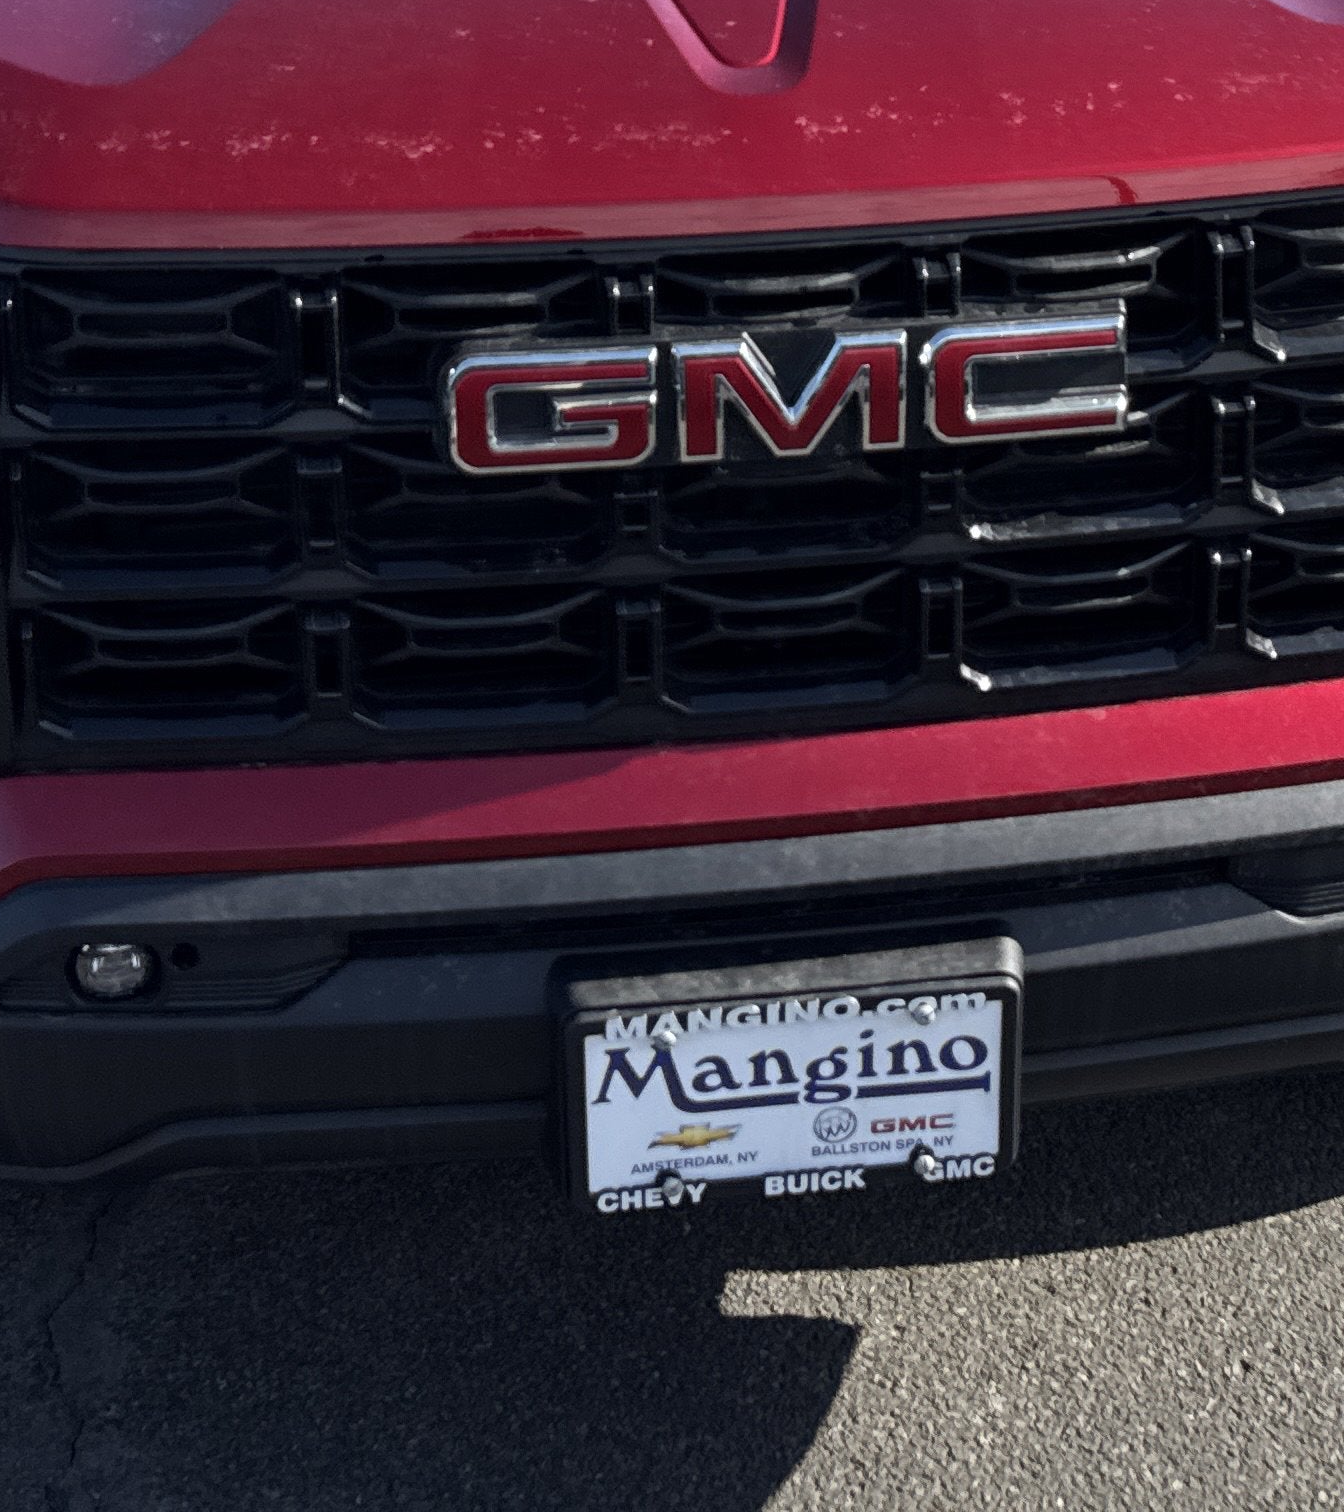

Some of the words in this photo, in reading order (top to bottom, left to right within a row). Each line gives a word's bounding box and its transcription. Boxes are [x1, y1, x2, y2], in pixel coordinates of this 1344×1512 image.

[450, 313, 1129, 475] GMC
[605, 992, 987, 1040] MANGINO.com
[591, 1028, 991, 1113] Mangino
[870, 1113, 956, 1134] GMC
[811, 1140, 891, 1157] BALLSTON
[933, 1135, 954, 1147] NY
[630, 1153, 733, 1175] AMSTERDAM,
[737, 1150, 759, 1164] NY
[764, 1168, 866, 1197] BUICK
